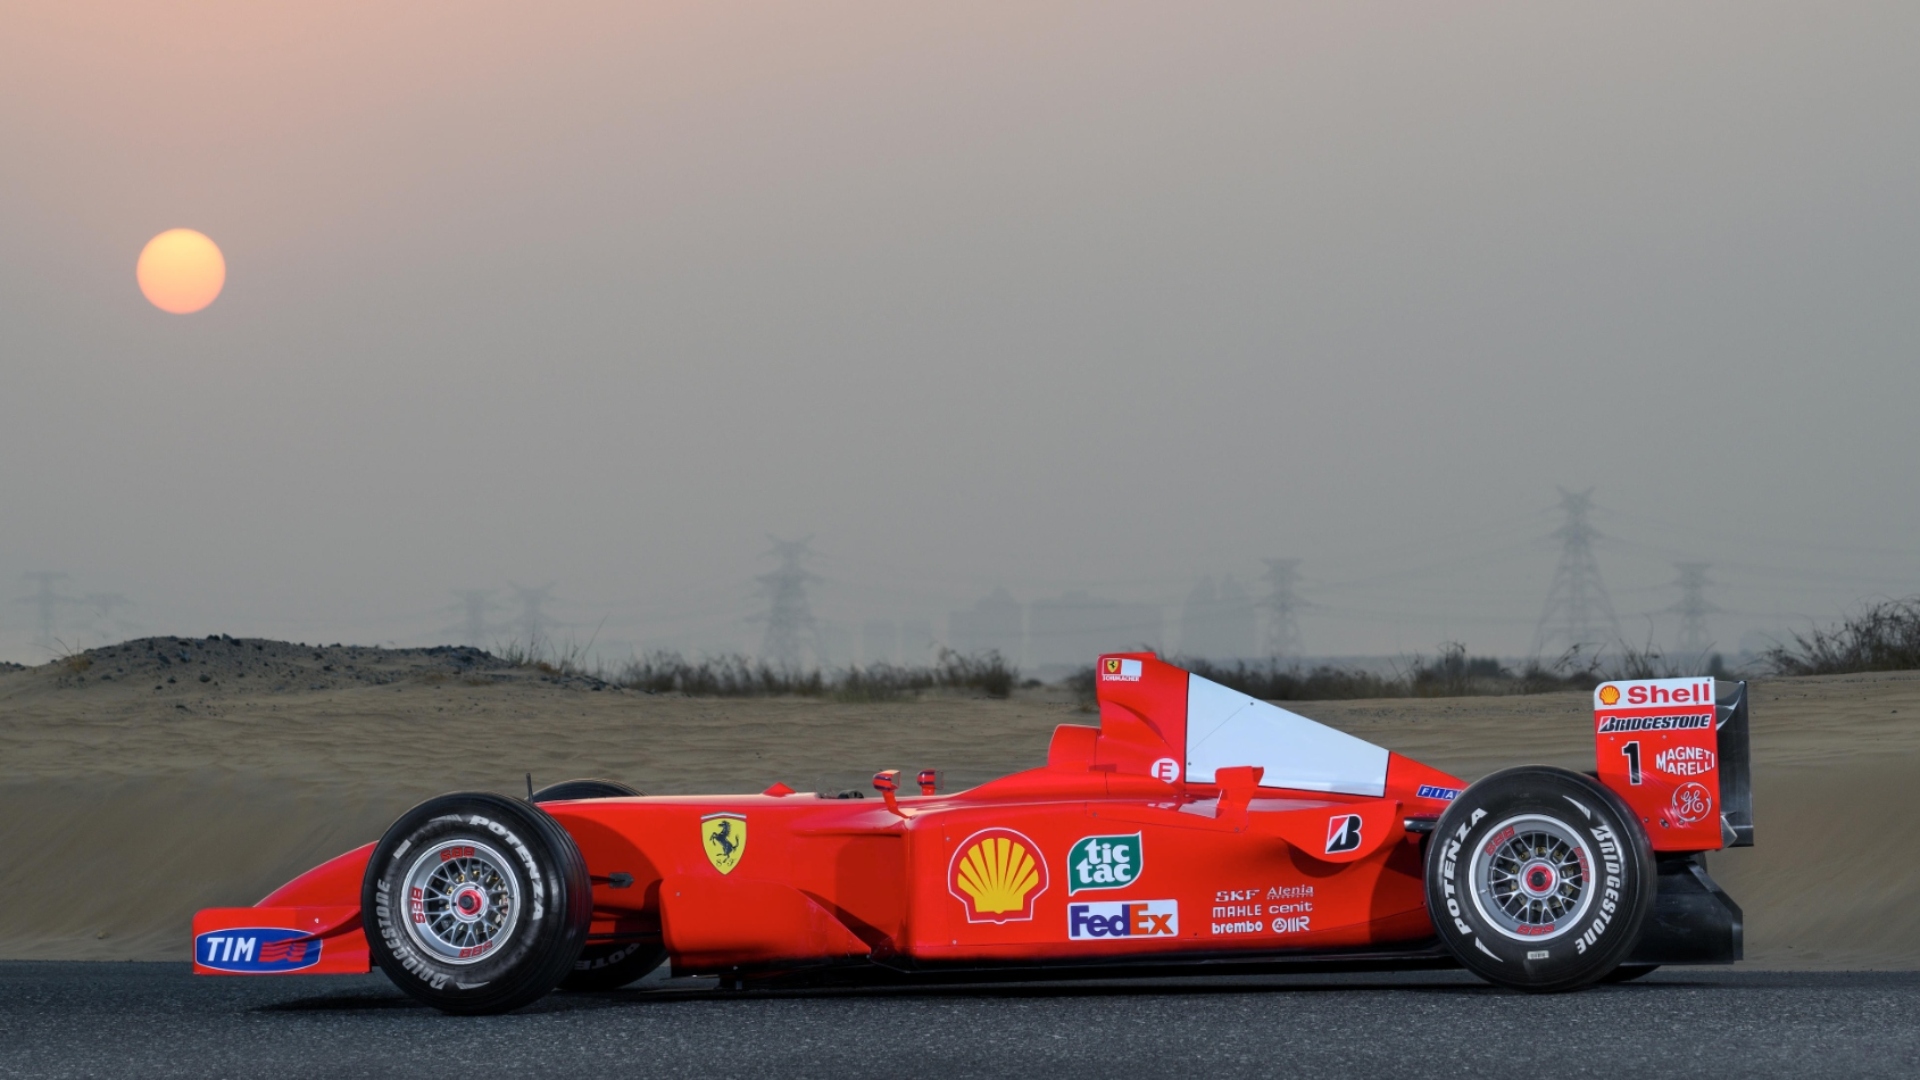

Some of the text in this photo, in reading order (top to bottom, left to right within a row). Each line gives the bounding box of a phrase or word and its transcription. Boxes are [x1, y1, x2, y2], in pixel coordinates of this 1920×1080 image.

[1627, 683, 1710, 704] Shell
[1599, 714, 1712, 733] BRIDGESTONE
[1157, 762, 1173, 781] E
[1622, 741, 1642, 785] 1
[1420, 787, 1458, 800] FIA
[440, 846, 476, 862] BBS
[1085, 839, 1130, 864] tic
[469, 815, 544, 921] POTENZA
[1075, 861, 1131, 884] tac
[1443, 807, 1488, 936] POTENZA
[1215, 889, 1260, 903] SKF
[1266, 884, 1314, 897] Alenia
[1575, 824, 1621, 955] BRIDGESTONE
[411, 886, 426, 924] BBS
[1212, 904, 1262, 918] MAHLE
[1268, 901, 1314, 914] cenit
[1070, 903, 1173, 937] FedEx
[1211, 920, 1263, 935] brembo
[376, 878, 451, 990] BRIDGESTONE
[206, 937, 256, 962] TIM
[573, 942, 641, 971] POTE
